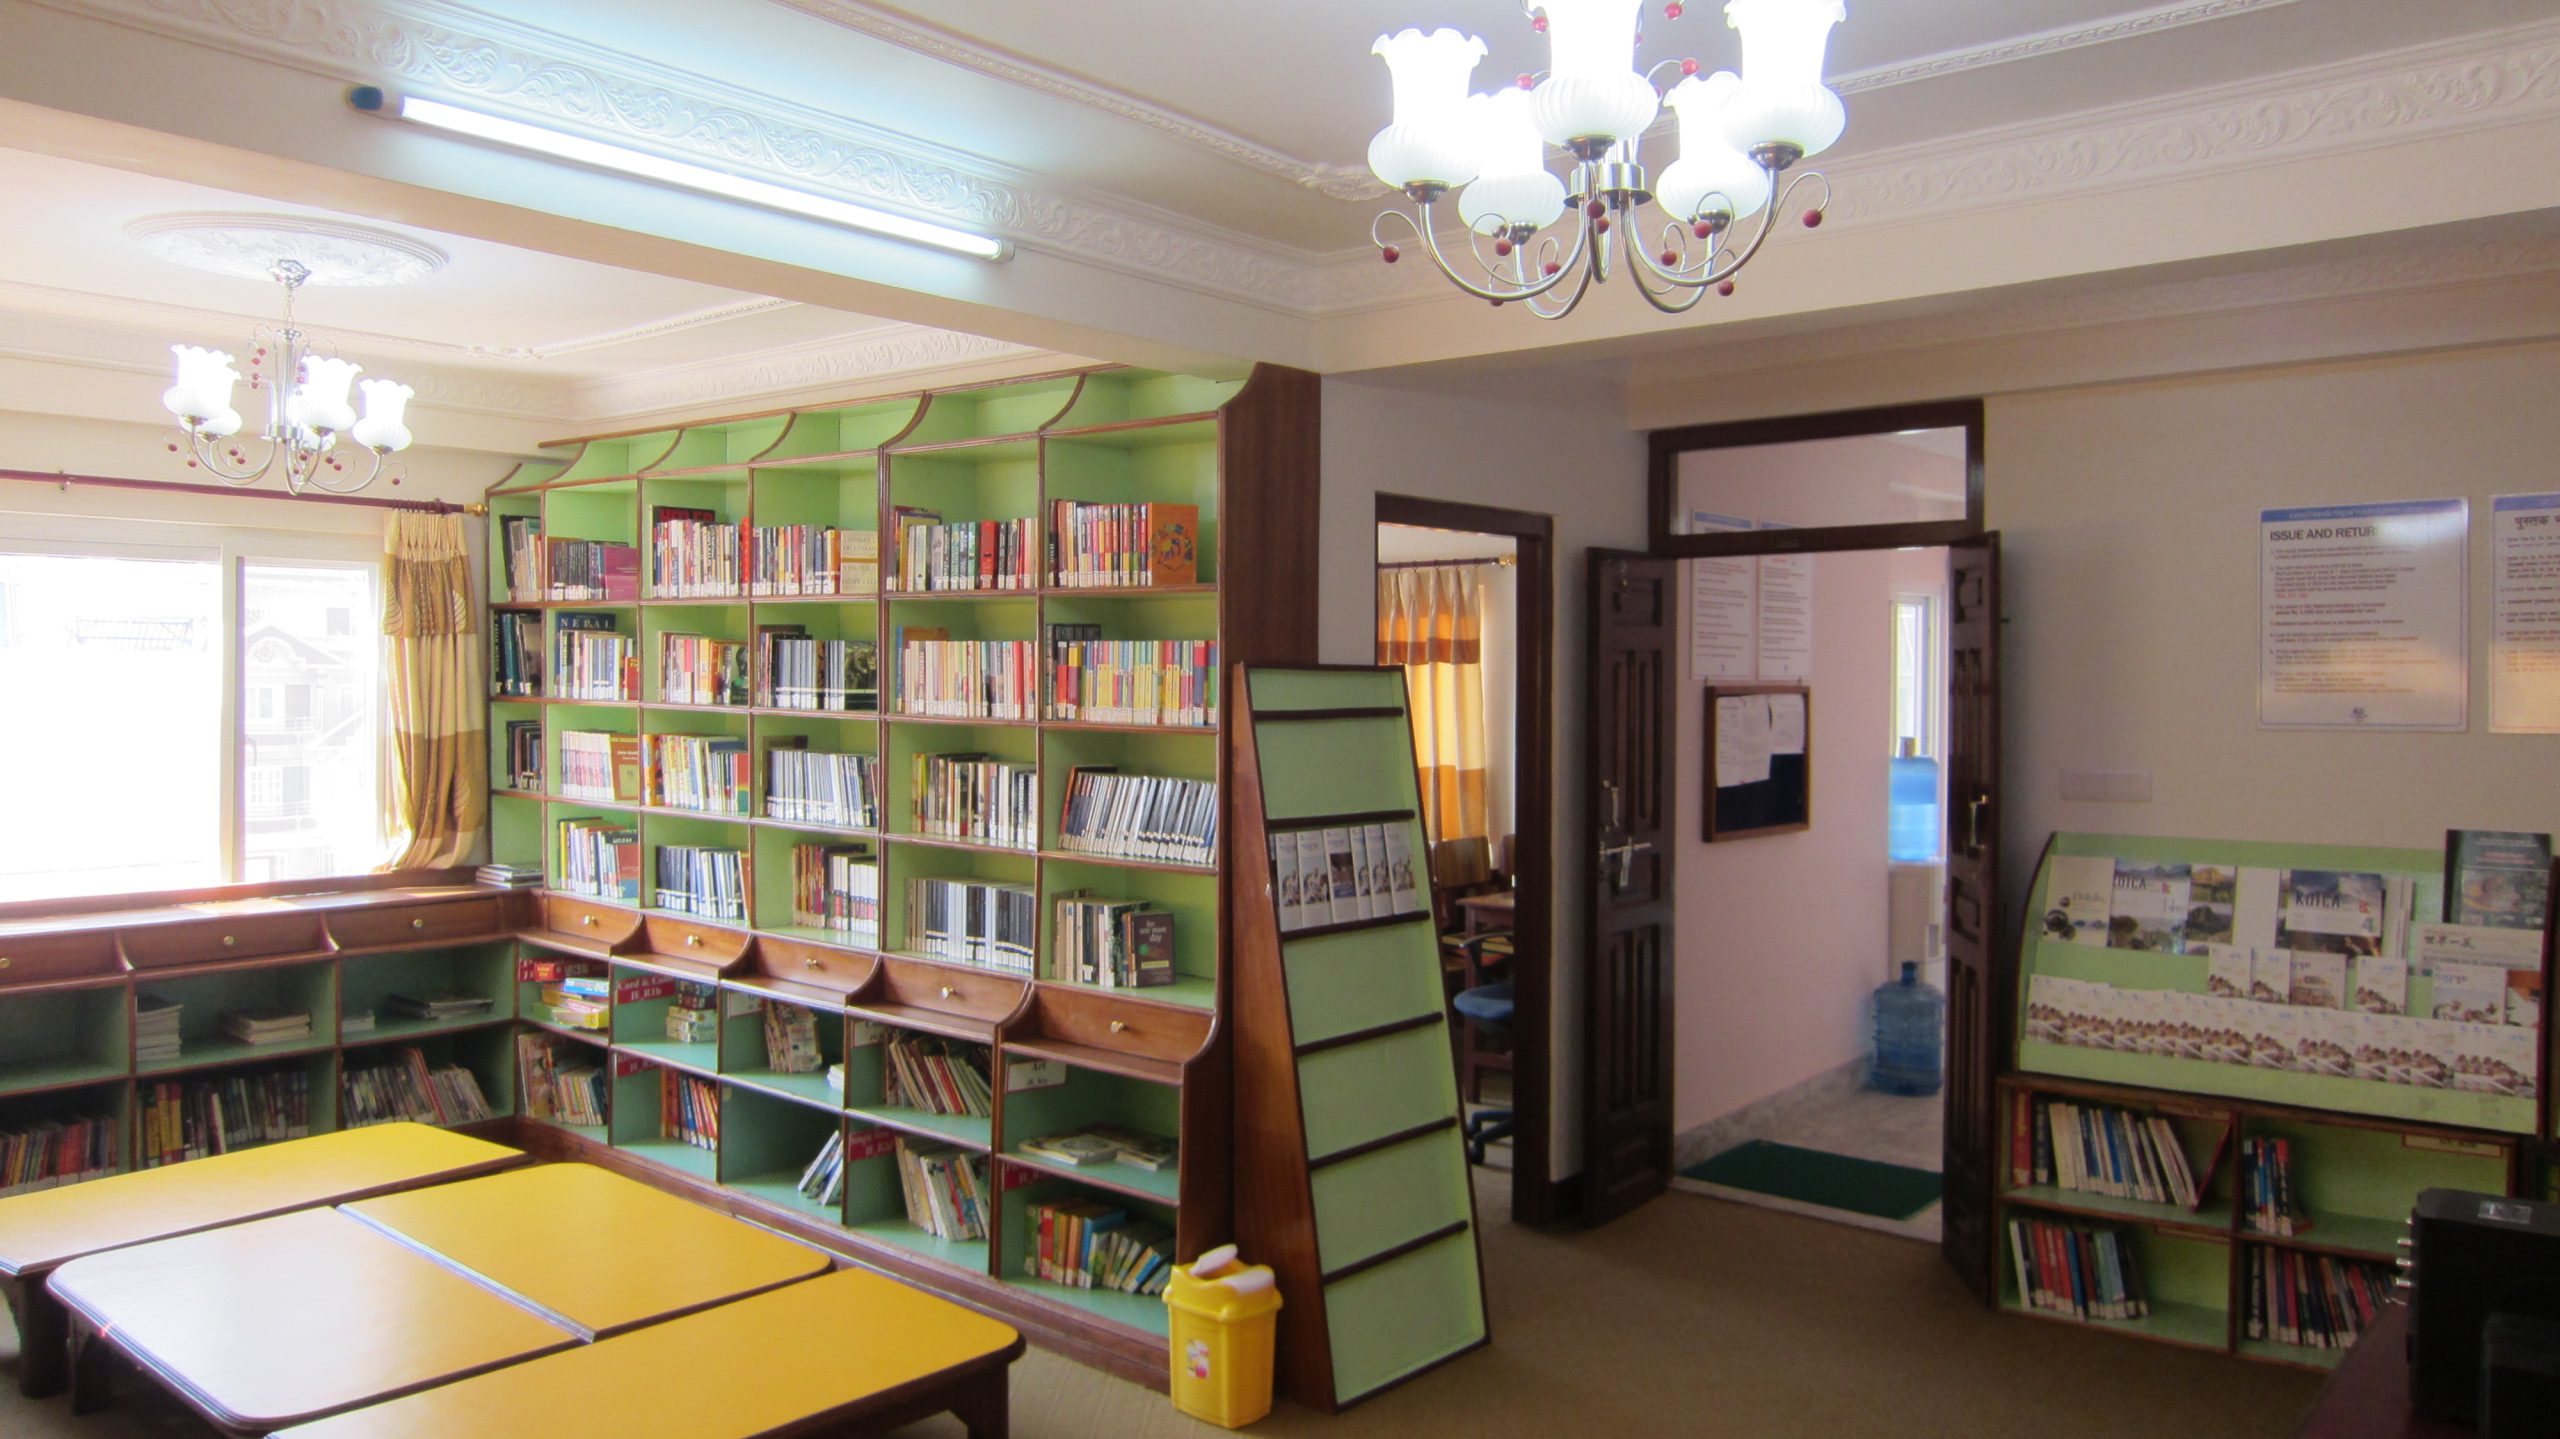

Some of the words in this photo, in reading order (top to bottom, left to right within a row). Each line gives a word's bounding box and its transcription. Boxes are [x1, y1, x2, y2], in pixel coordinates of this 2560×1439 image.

[2270, 529, 2304, 541] ISSUE
[2306, 528, 2333, 539] AND
[2295, 890, 2340, 909] KOICA
